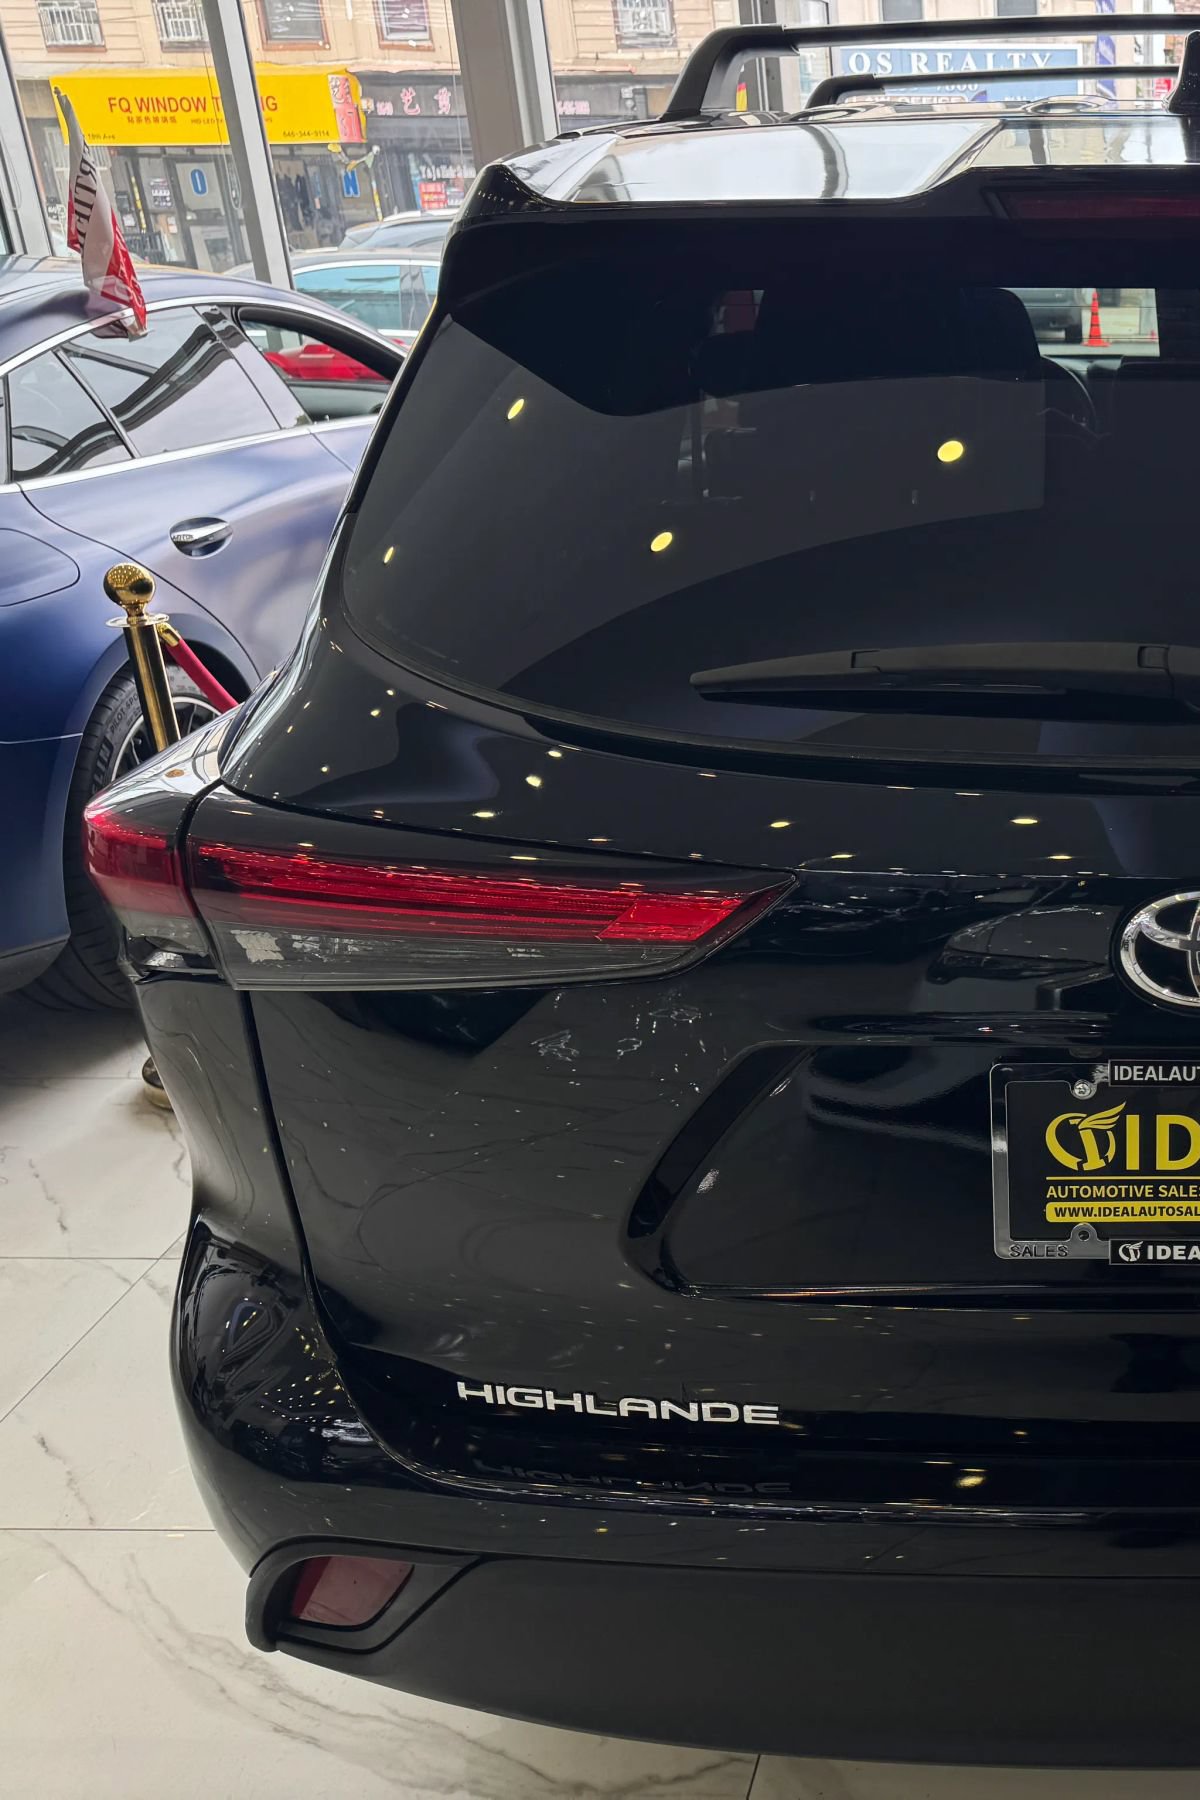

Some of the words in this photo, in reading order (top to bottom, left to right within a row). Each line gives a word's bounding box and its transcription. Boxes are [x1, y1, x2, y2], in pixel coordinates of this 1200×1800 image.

[908, 52, 1054, 74] REALTY
[108, 96, 133, 114] FQ
[134, 96, 207, 113] WINDOW
[1046, 1184, 1154, 1199] AUTOMOTIVE
[1009, 1244, 1069, 1259] SALES
[456, 1381, 780, 1425] HIGHLANDE
